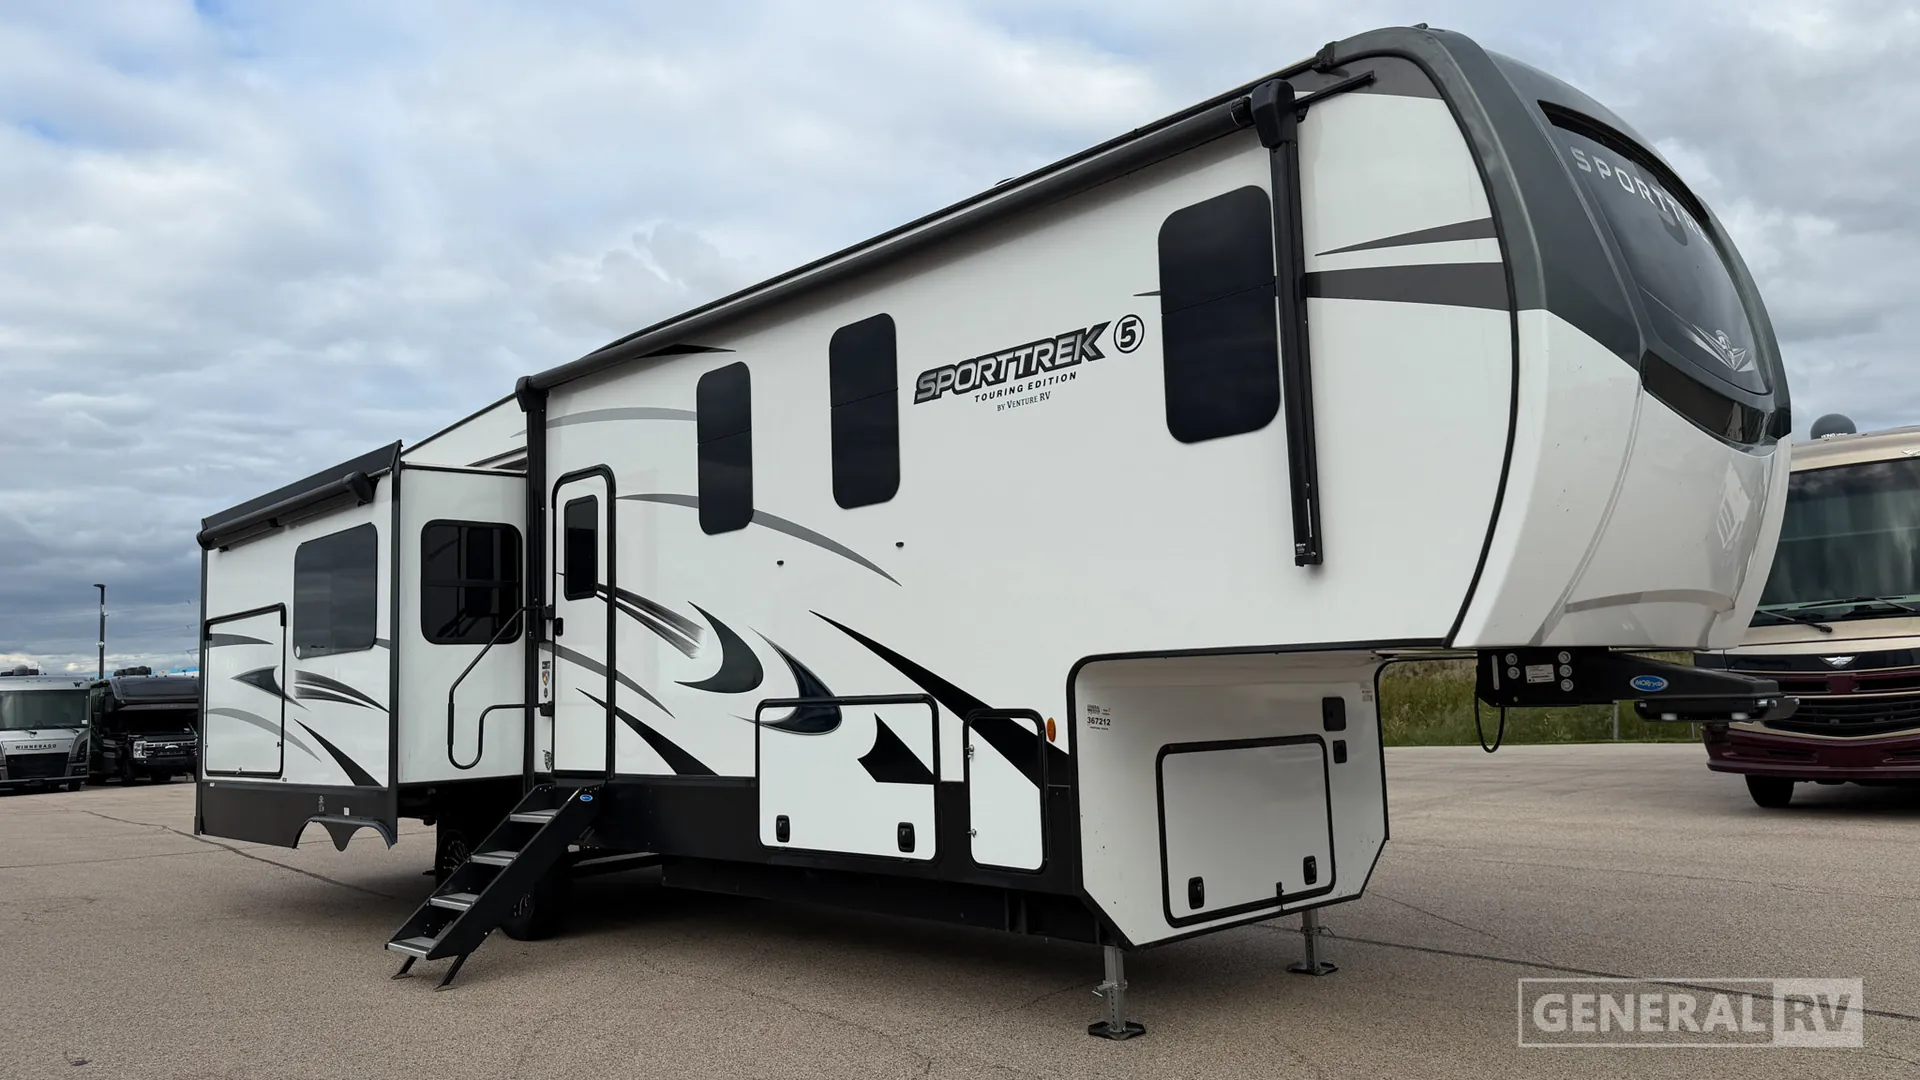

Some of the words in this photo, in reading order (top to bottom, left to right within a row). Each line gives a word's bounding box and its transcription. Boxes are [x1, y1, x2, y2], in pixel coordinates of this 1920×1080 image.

[1570, 146, 1710, 246] SPORTTR
[914, 321, 1111, 404] SPORTTREK
[974, 384, 1024, 402] TOURING
[1027, 371, 1077, 390] EDITION
[1039, 391, 1051, 401] RV
[1087, 716, 1111, 726] 367212
